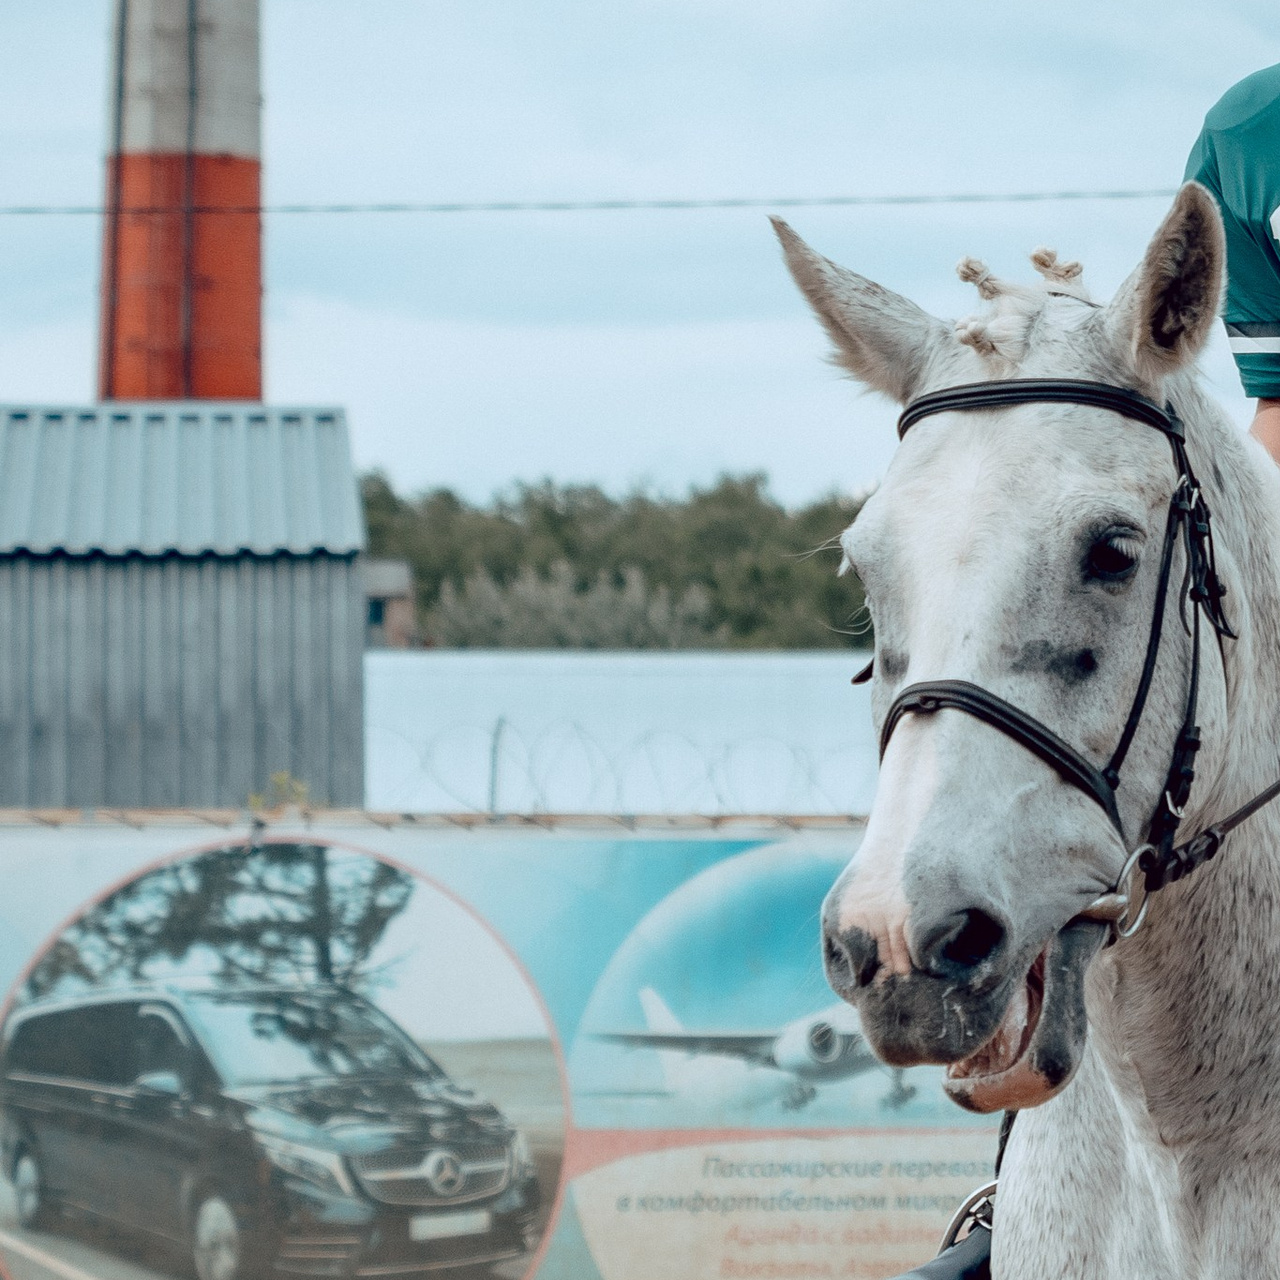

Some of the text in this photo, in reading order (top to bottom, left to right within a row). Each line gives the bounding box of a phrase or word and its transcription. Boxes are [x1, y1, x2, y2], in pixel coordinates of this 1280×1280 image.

[702, 1157, 994, 1183] Пассажирские перевоз
[635, 1190, 887, 1214] комфортабельном
